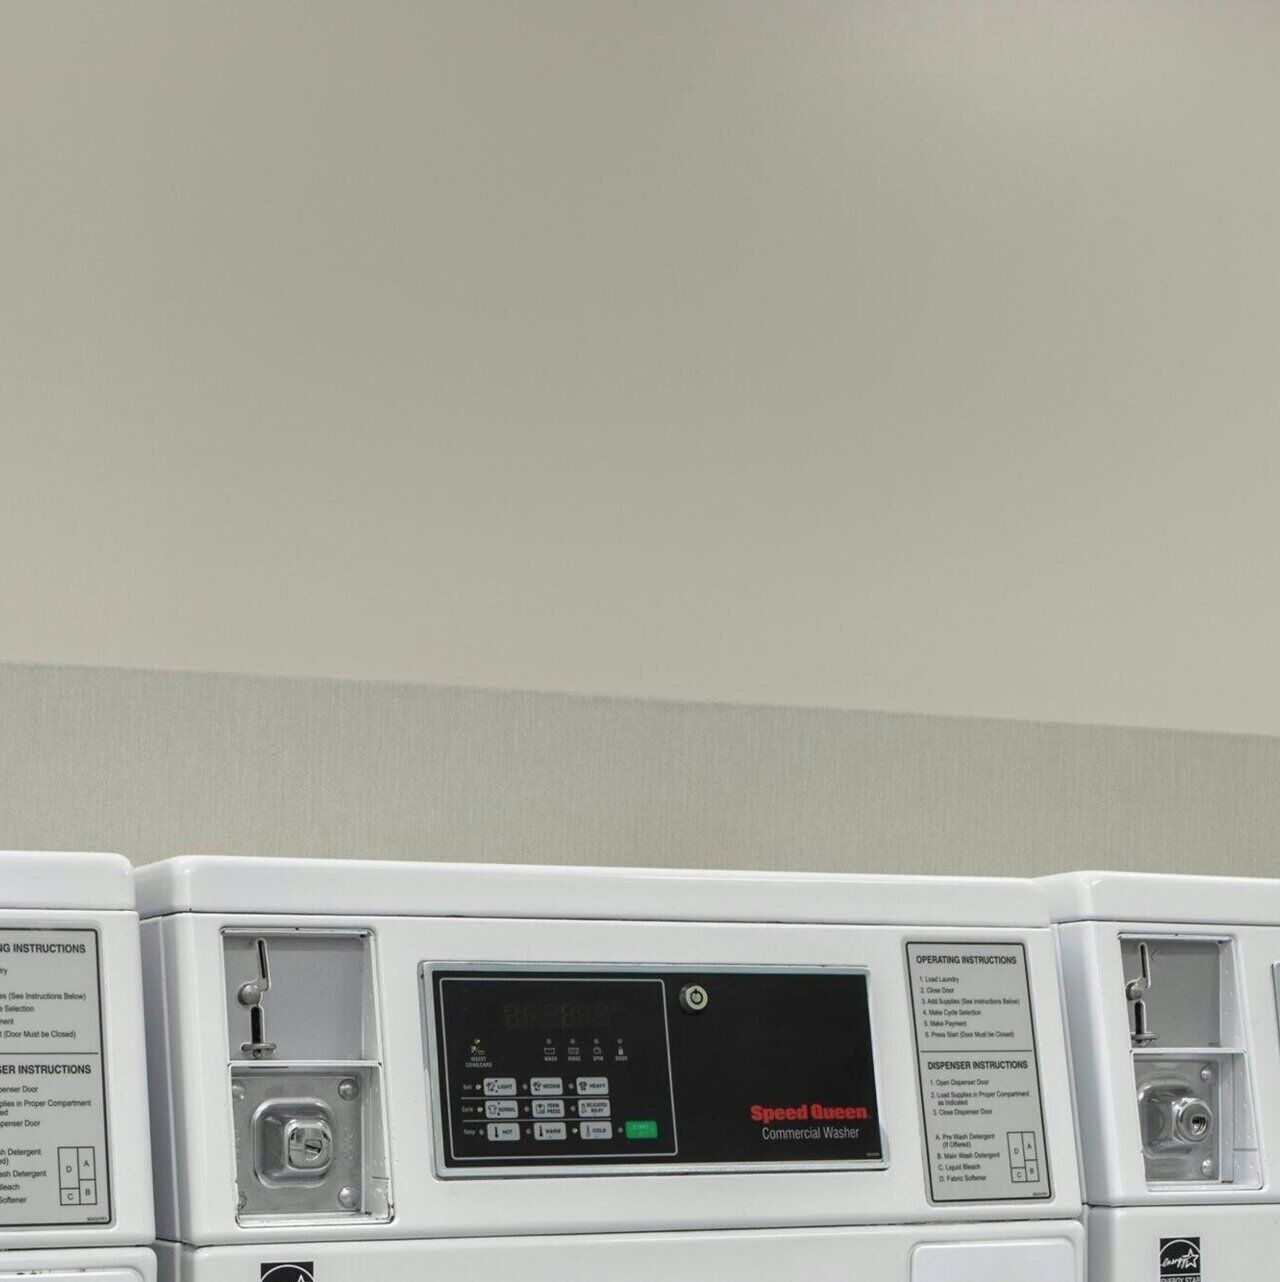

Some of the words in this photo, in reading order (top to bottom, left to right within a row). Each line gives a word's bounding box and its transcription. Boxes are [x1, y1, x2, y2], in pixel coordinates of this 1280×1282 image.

[13, 944, 85, 953] INSTRUCTIONS
[916, 956, 960, 964] OPERATING
[961, 956, 1016, 964] INSTRUCTIONS
[8, 992, 24, 1001] (See
[64, 992, 86, 1001] Below)
[18, 1065, 91, 1074] INSTRUCTIONS
[928, 1061, 971, 1070] DISPENSER
[973, 1061, 1028, 1069] INSTRUCTIONS
[24, 1100, 46, 1108] Proper
[47, 1100, 91, 1108] Compartment
[751, 1105, 808, 1123] Speed
[811, 1104, 867, 1119] Queen
[762, 1127, 820, 1140] Commercial
[823, 1127, 859, 1138] Washer
[8, 1149, 41, 1157] Detergent
[13, 1170, 46, 1178] Detergent
